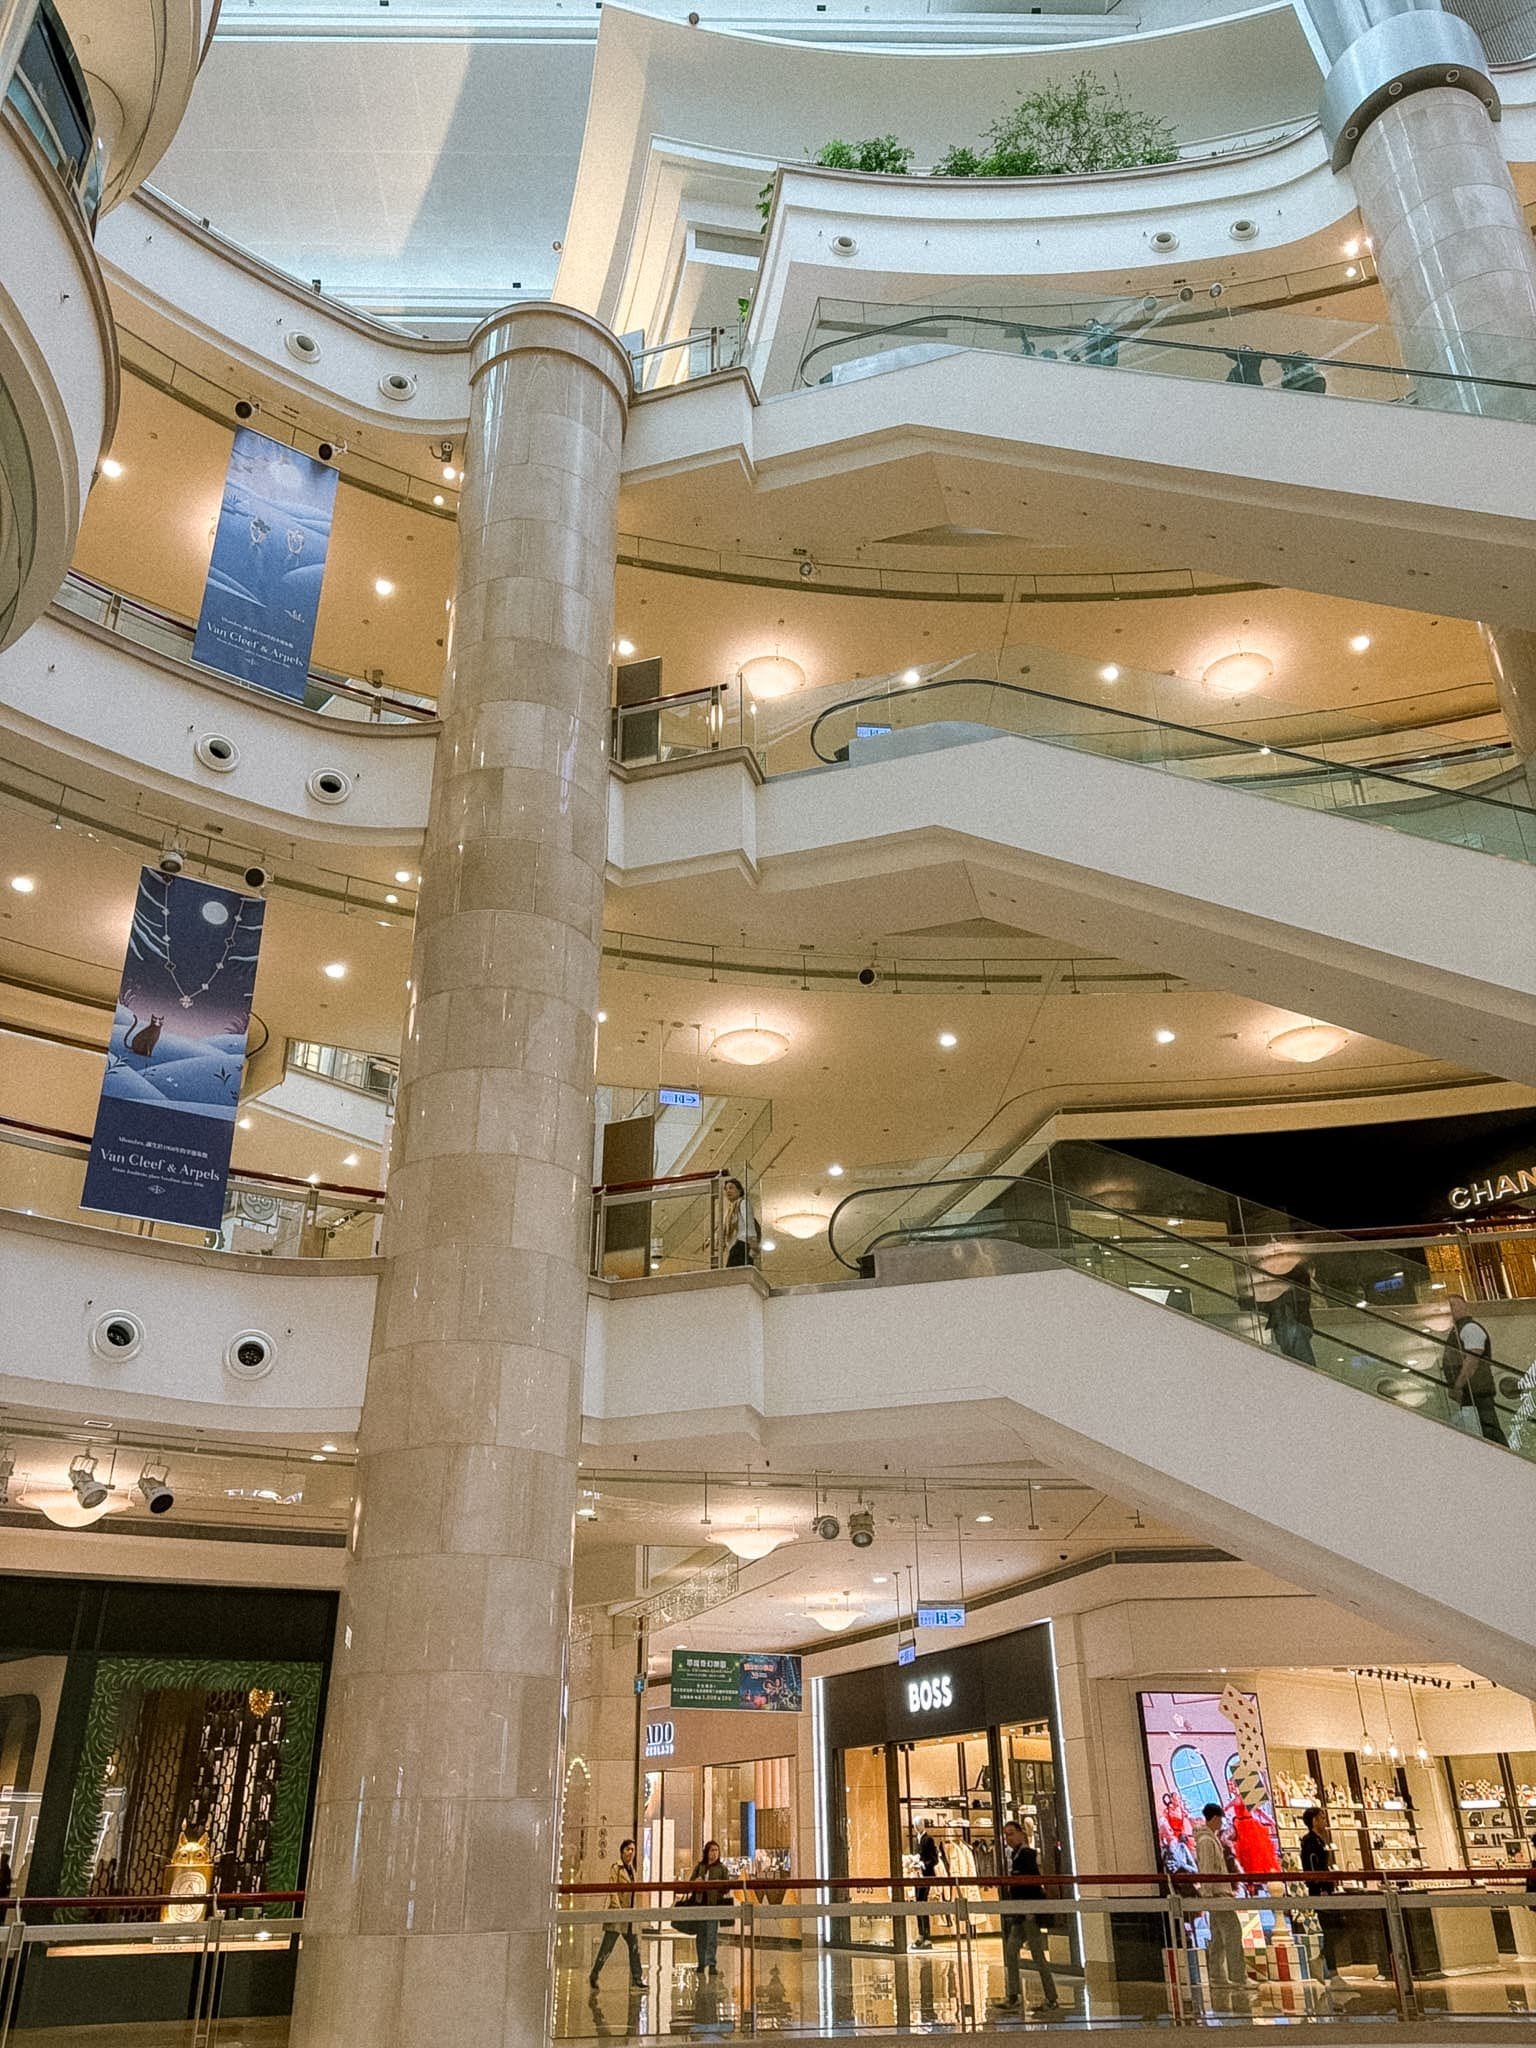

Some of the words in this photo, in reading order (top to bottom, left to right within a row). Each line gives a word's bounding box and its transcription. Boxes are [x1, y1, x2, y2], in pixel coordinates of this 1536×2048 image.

[207, 621, 228, 638] Van
[229, 630, 260, 649] Cleef
[260, 645, 268, 654] &
[271, 648, 304, 667] Arpels
[100, 1147, 125, 1163] Van
[128, 1153, 166, 1171] Cleef
[166, 1163, 177, 1174] &
[179, 1163, 220, 1181] Arpels
[1448, 1166, 1536, 1209] CHAN
[908, 1675, 953, 1713] BOSS
